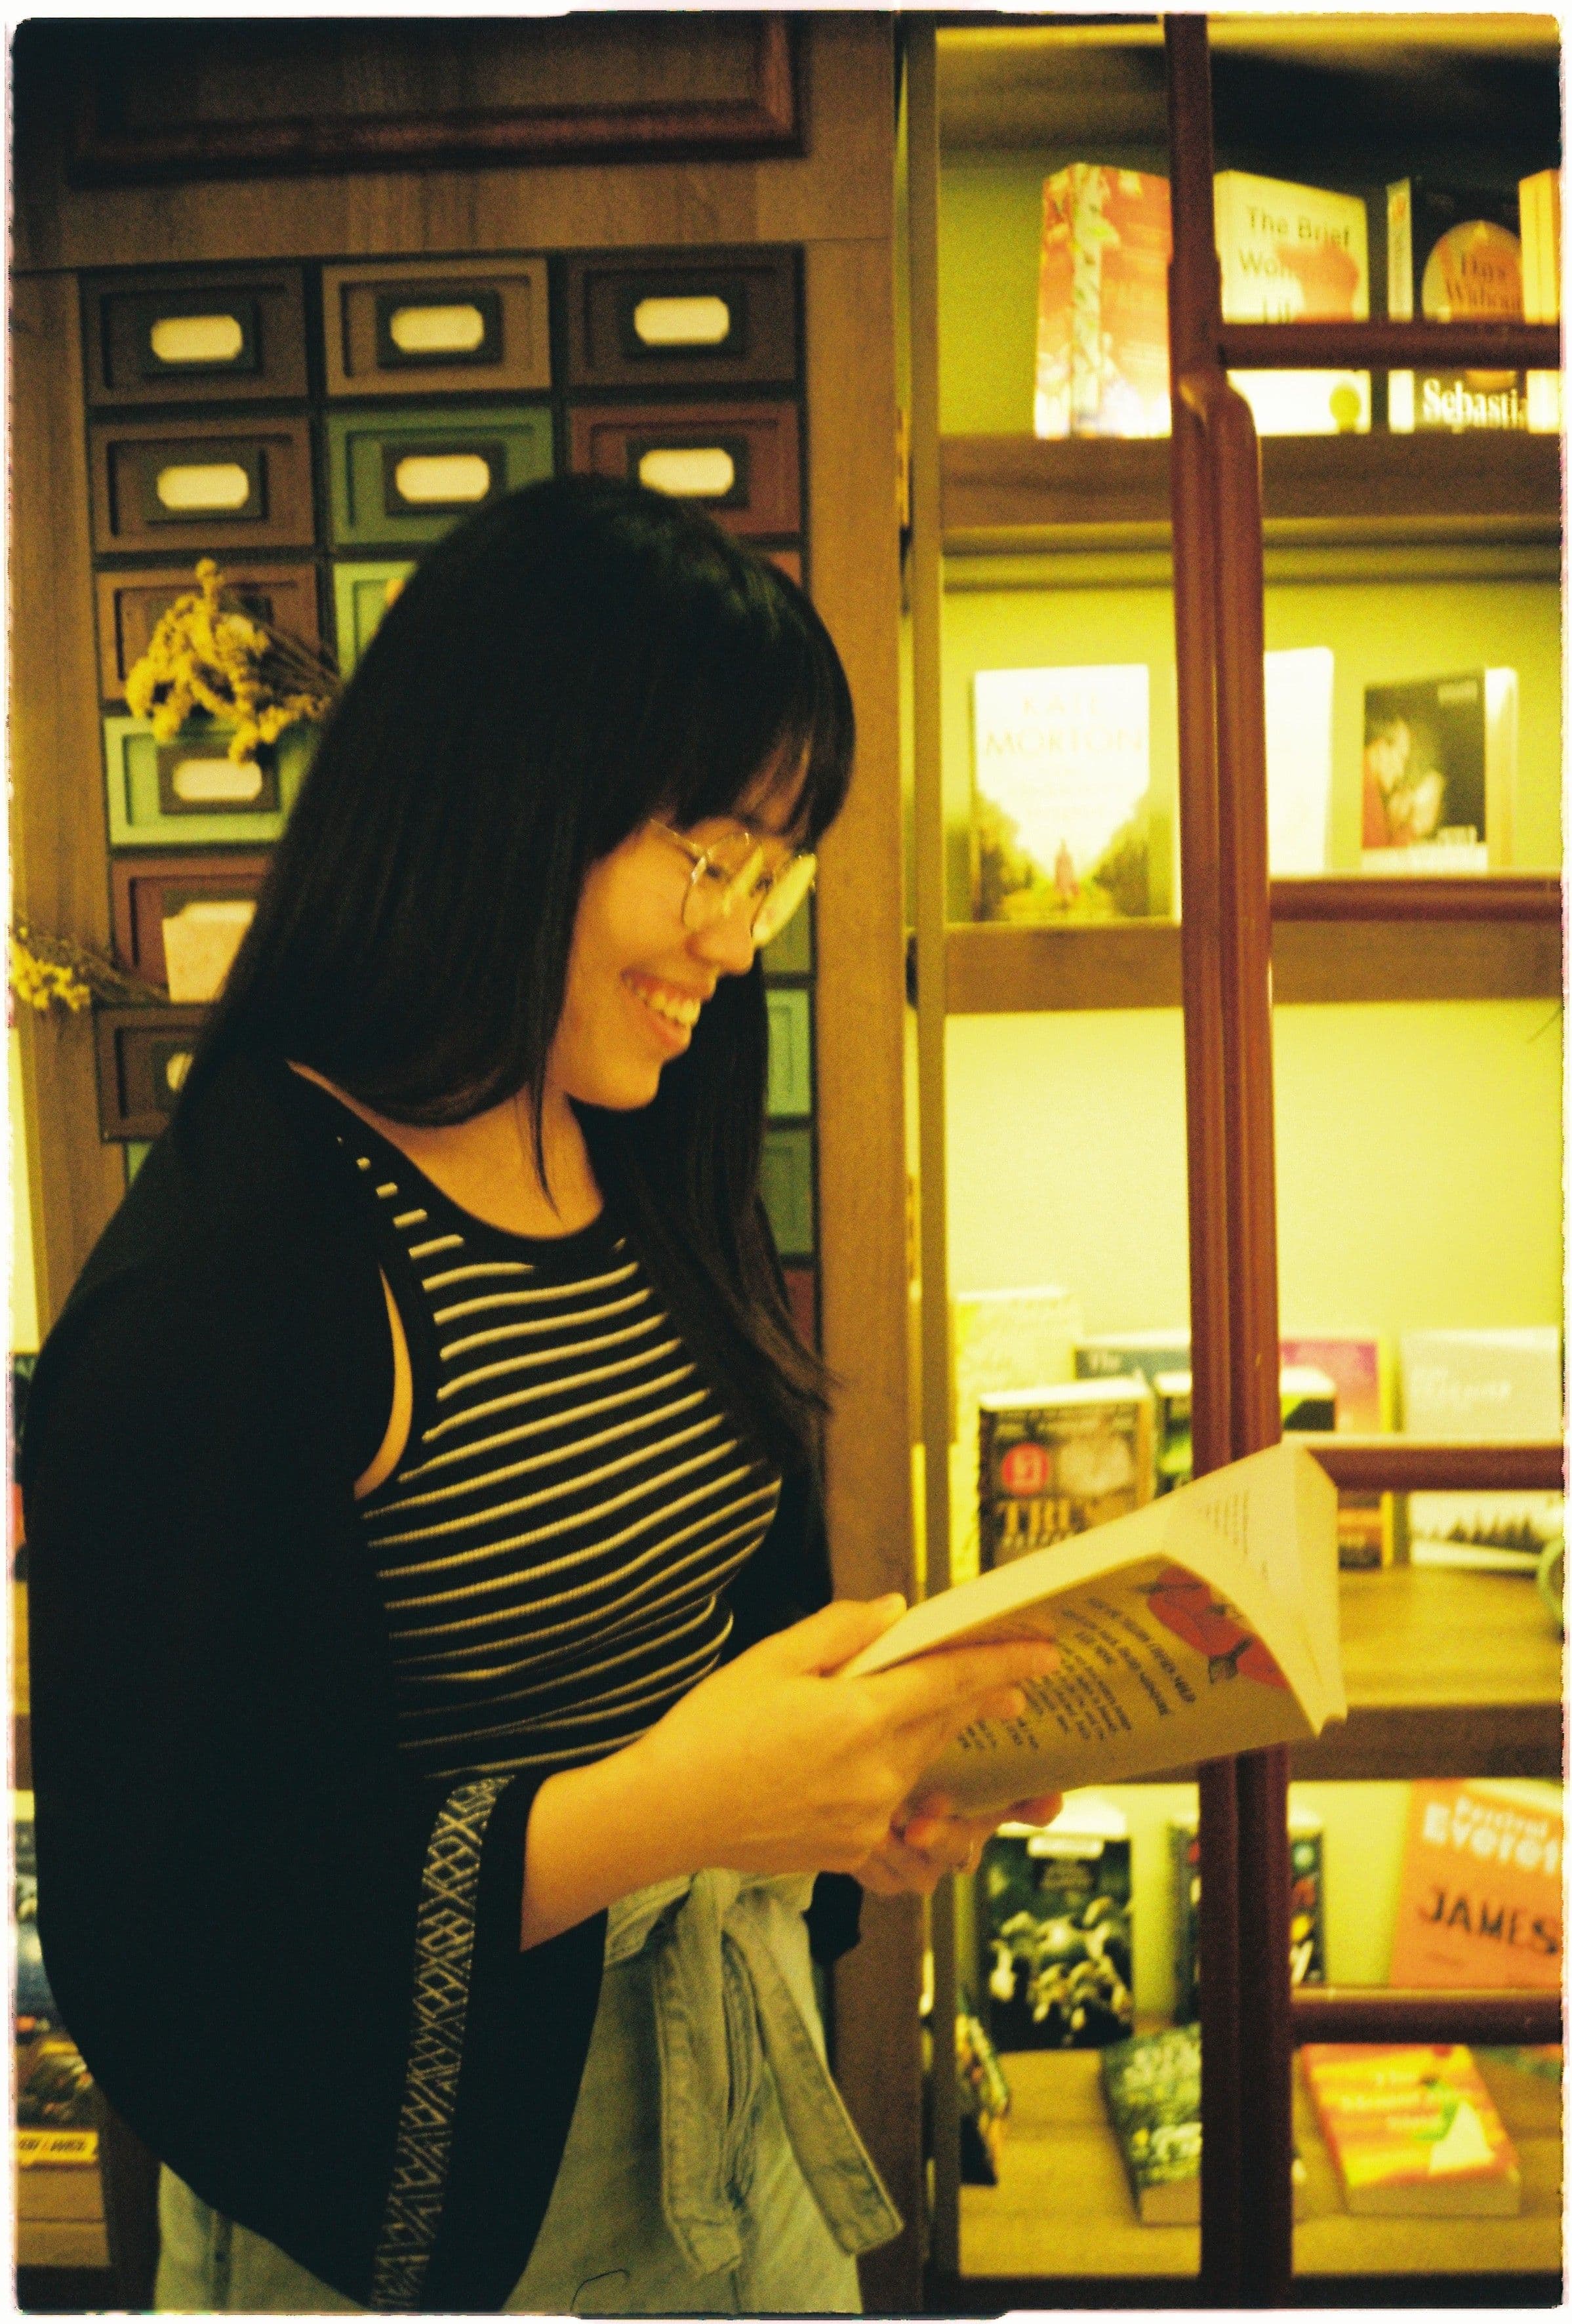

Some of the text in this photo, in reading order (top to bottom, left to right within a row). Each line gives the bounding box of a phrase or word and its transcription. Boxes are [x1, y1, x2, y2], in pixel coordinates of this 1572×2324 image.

[1246, 205, 1350, 247] The Brief
[985, 726, 1142, 756] MORTON
[1415, 1884, 1561, 1957] JAMES
